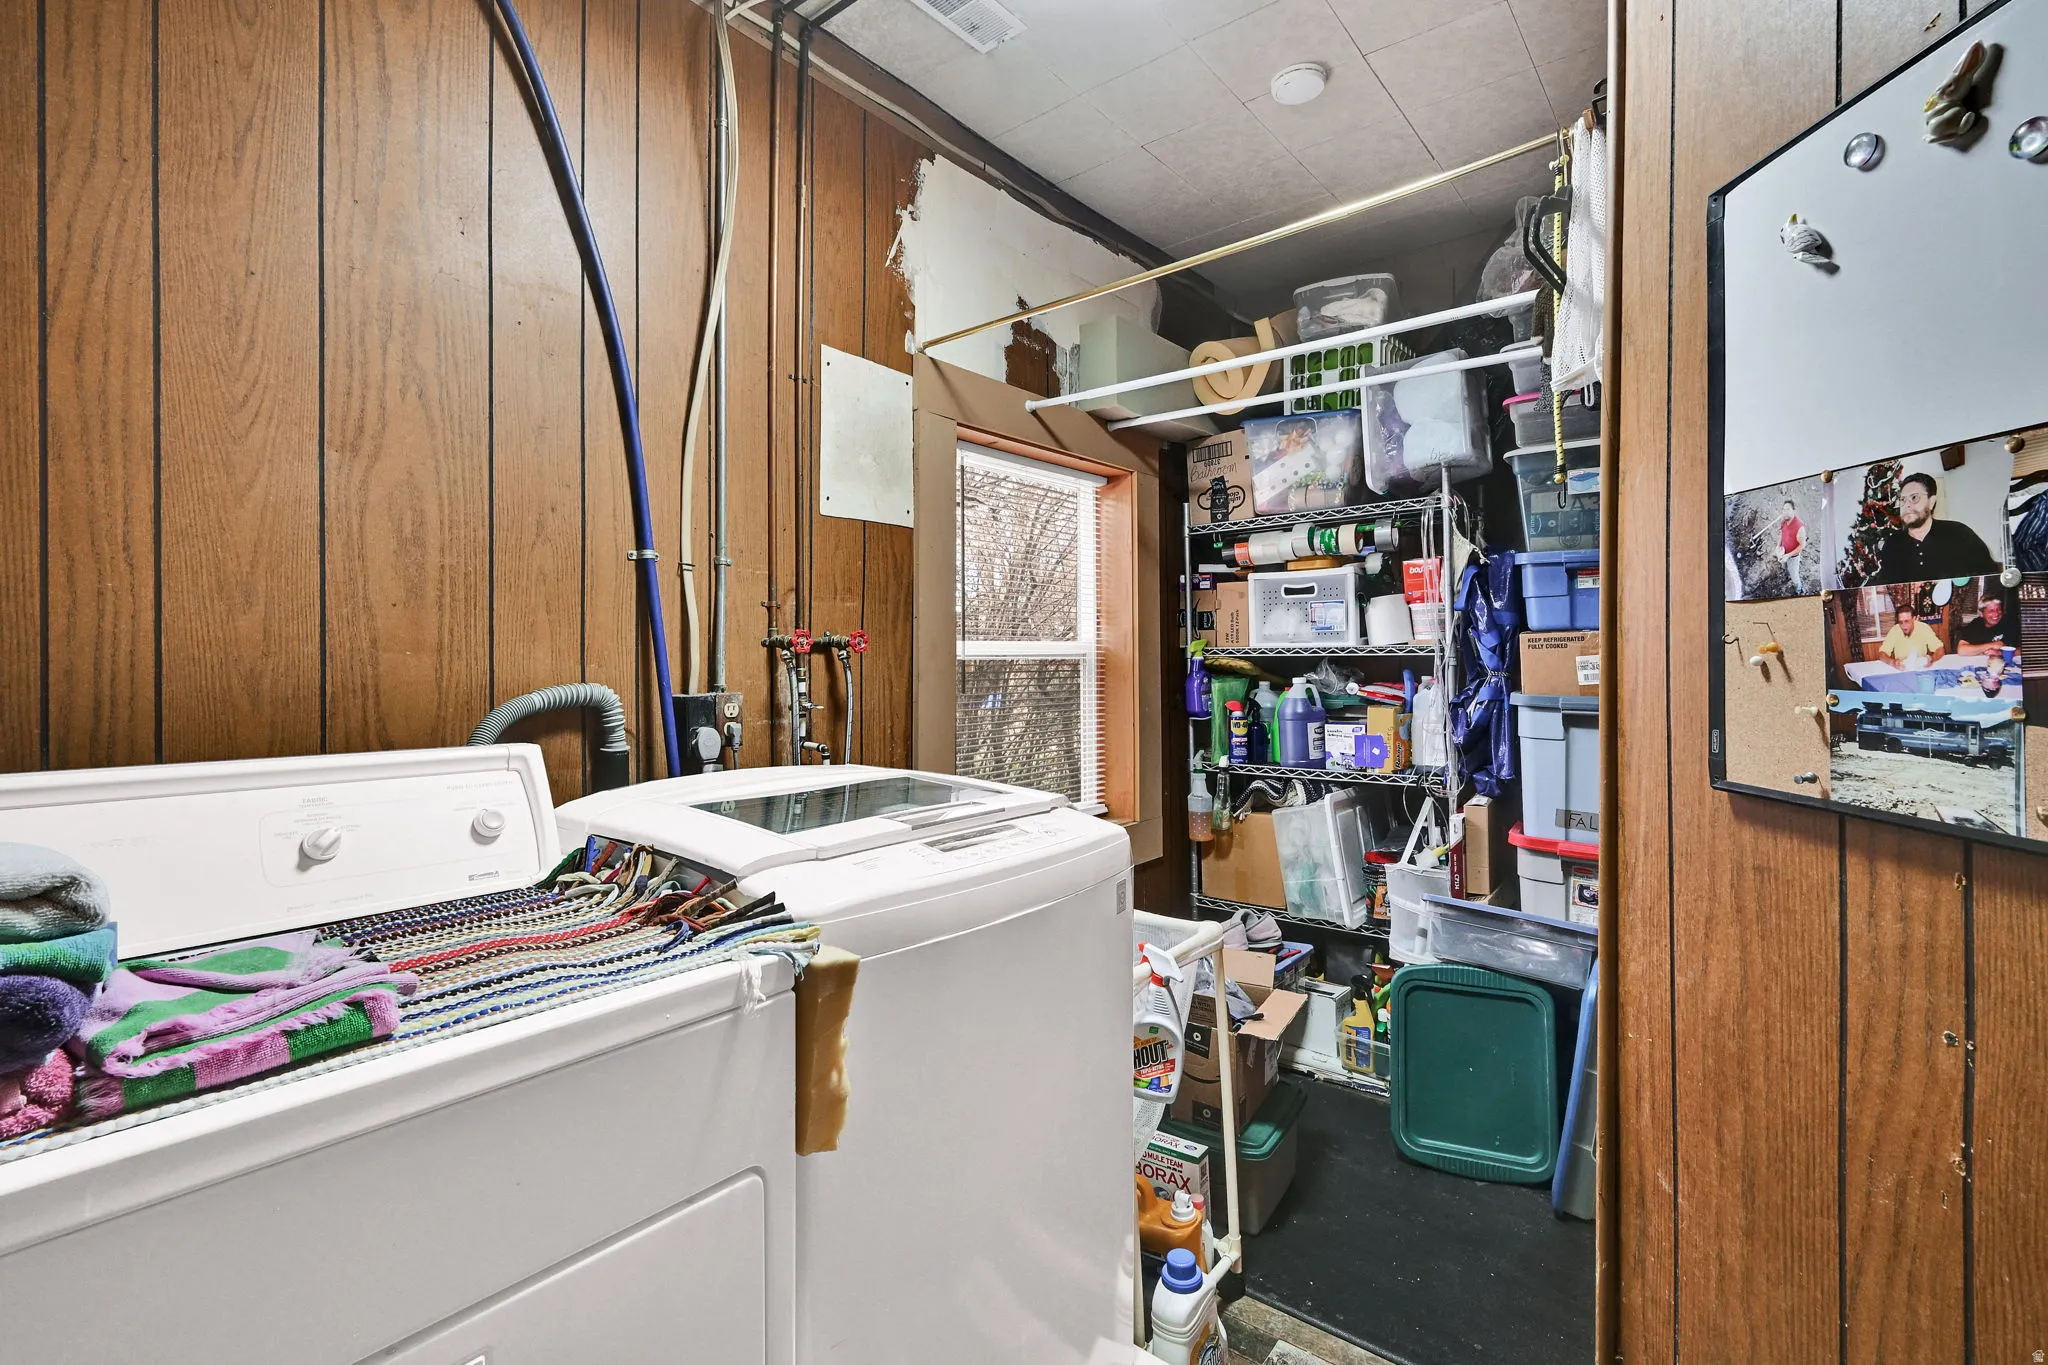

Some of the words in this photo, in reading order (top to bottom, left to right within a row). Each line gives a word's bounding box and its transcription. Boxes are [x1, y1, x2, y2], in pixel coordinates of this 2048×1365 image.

[1543, 635, 1585, 643] REFRIGERATED
[1147, 1151, 1165, 1164] MULE
[1165, 1157, 1184, 1169] TEAM
